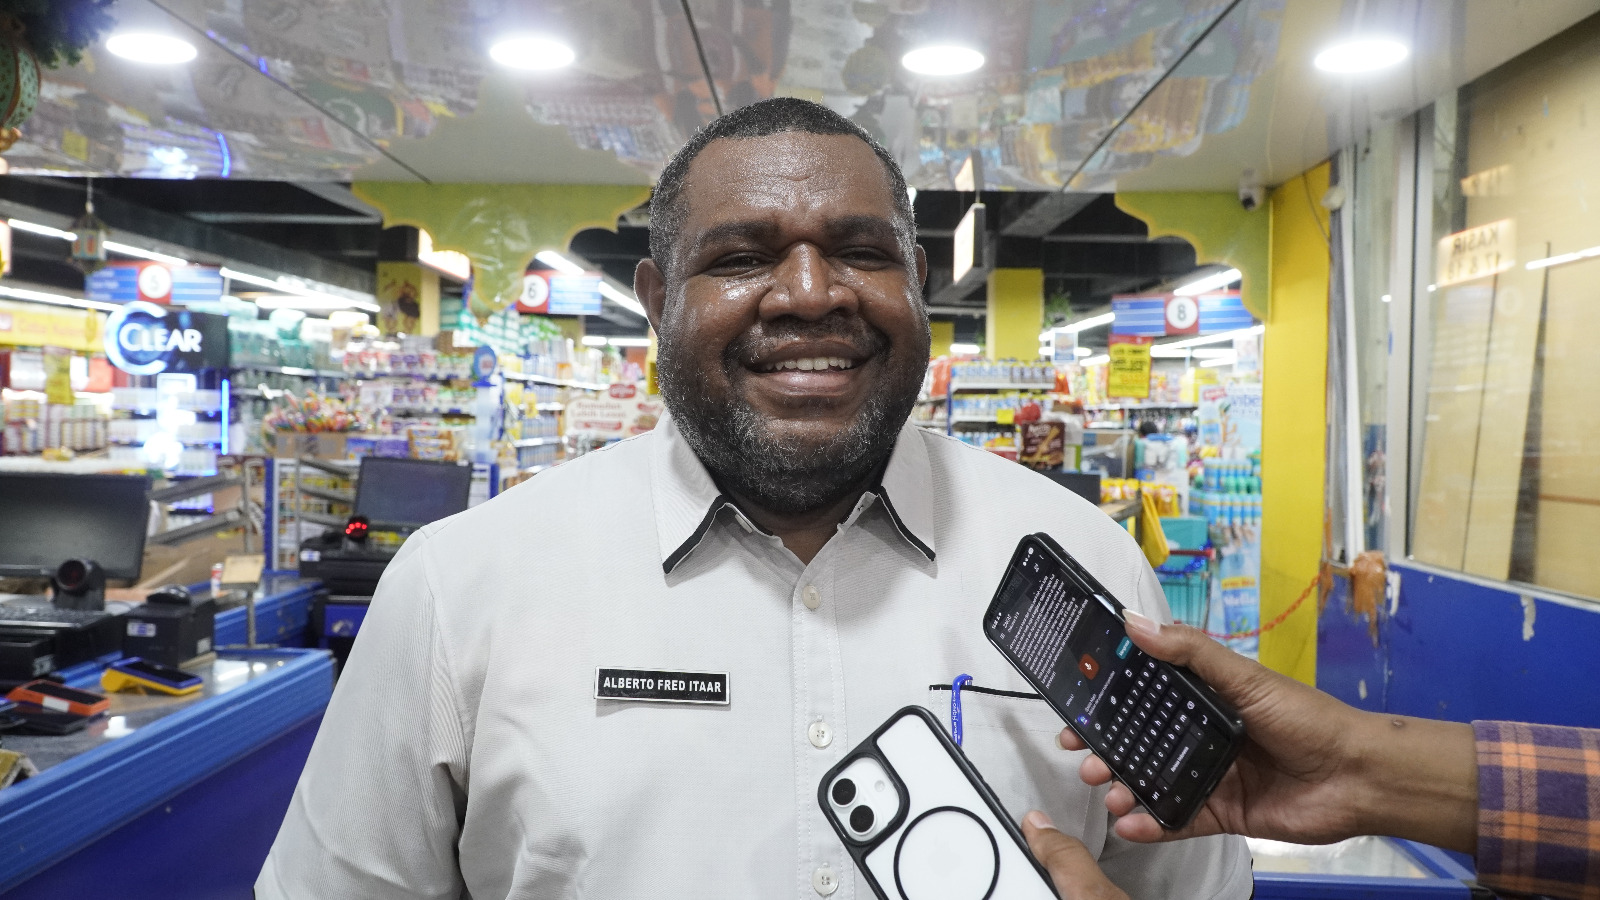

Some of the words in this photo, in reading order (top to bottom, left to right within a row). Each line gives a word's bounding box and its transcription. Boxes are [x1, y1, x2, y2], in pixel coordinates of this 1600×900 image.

[528, 282, 536, 299] 6
[1177, 303, 1187, 321] 8
[119, 322, 202, 353] CLEAR
[603, 676, 654, 690] ALBERTO
[657, 679, 686, 691] FRED
[689, 680, 722, 692] ITAAR
